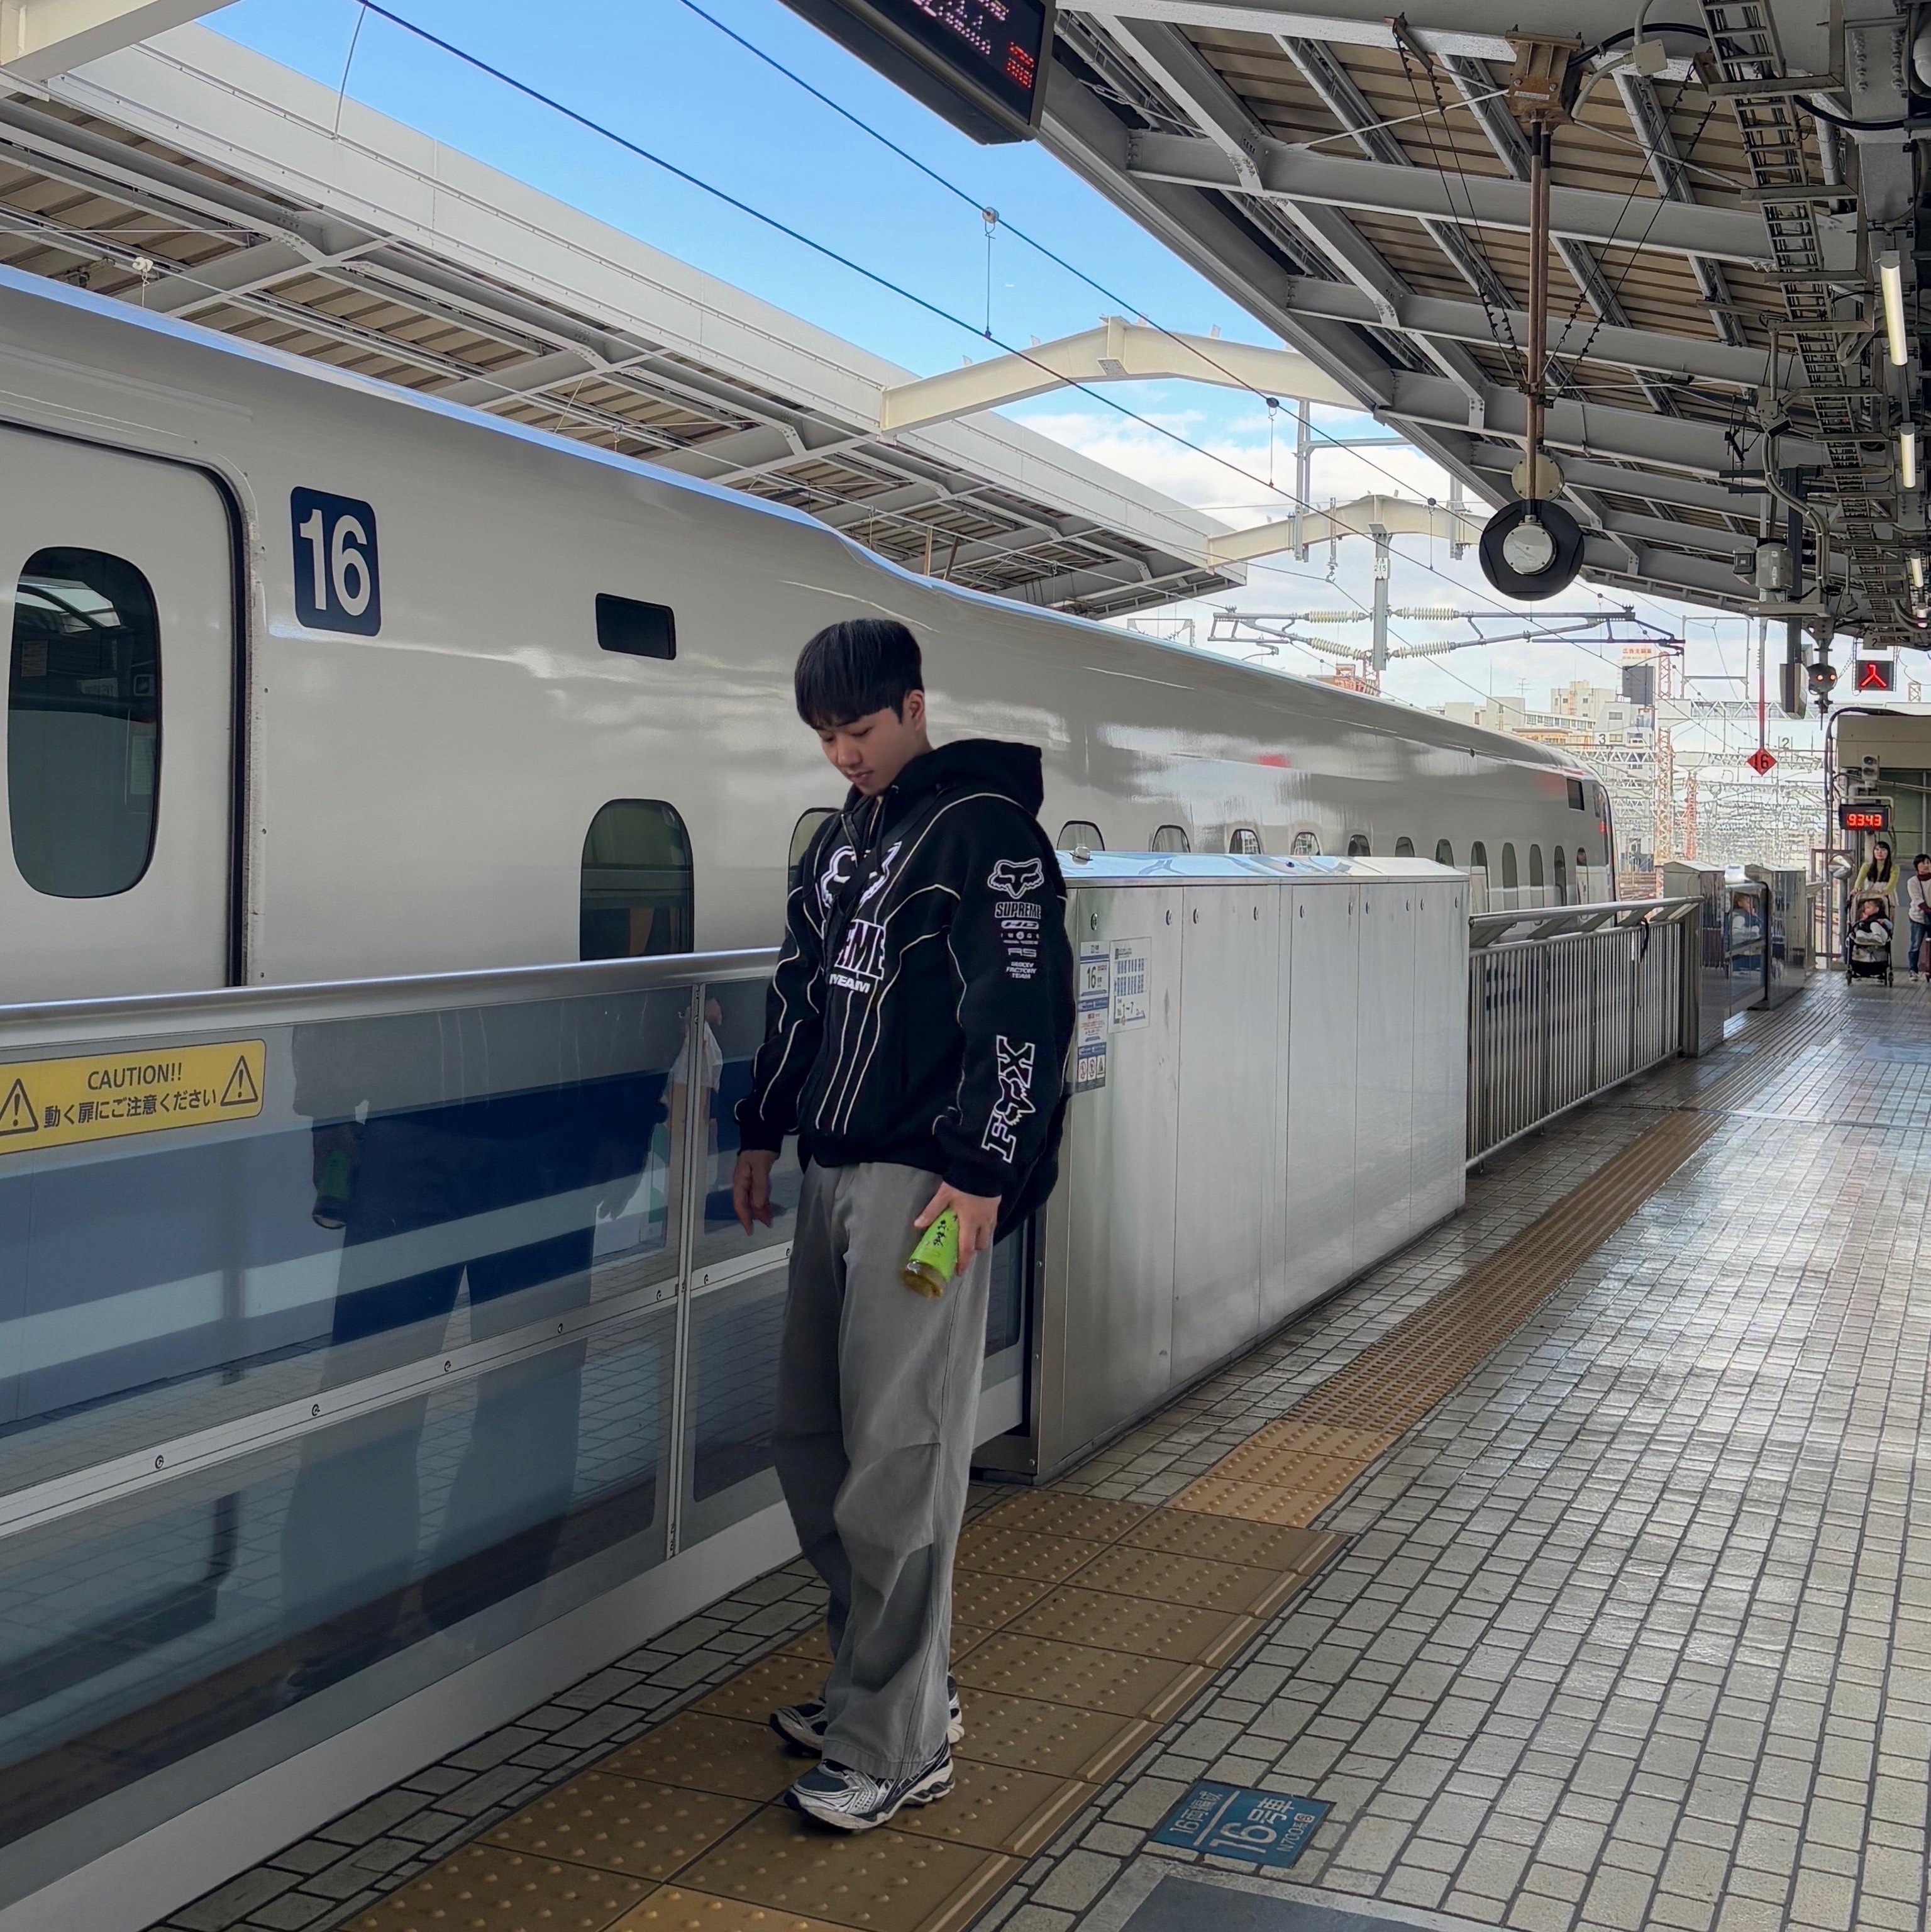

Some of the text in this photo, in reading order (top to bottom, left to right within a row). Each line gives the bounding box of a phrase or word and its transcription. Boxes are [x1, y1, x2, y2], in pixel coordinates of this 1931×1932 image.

[299, 508, 371, 616] 16
[1754, 753, 1769, 769] 16
[1848, 813, 1882, 826] 9343
[995, 901, 1041, 920] SUPREME
[1087, 966, 1097, 989] 16
[87, 1062, 182, 1091] CAUTION!!
[44, 1089, 216, 1128] 動く扉にご注意ください
[1170, 1790, 1223, 1834] 16両編成
[1209, 1797, 1295, 1854] 16号車
